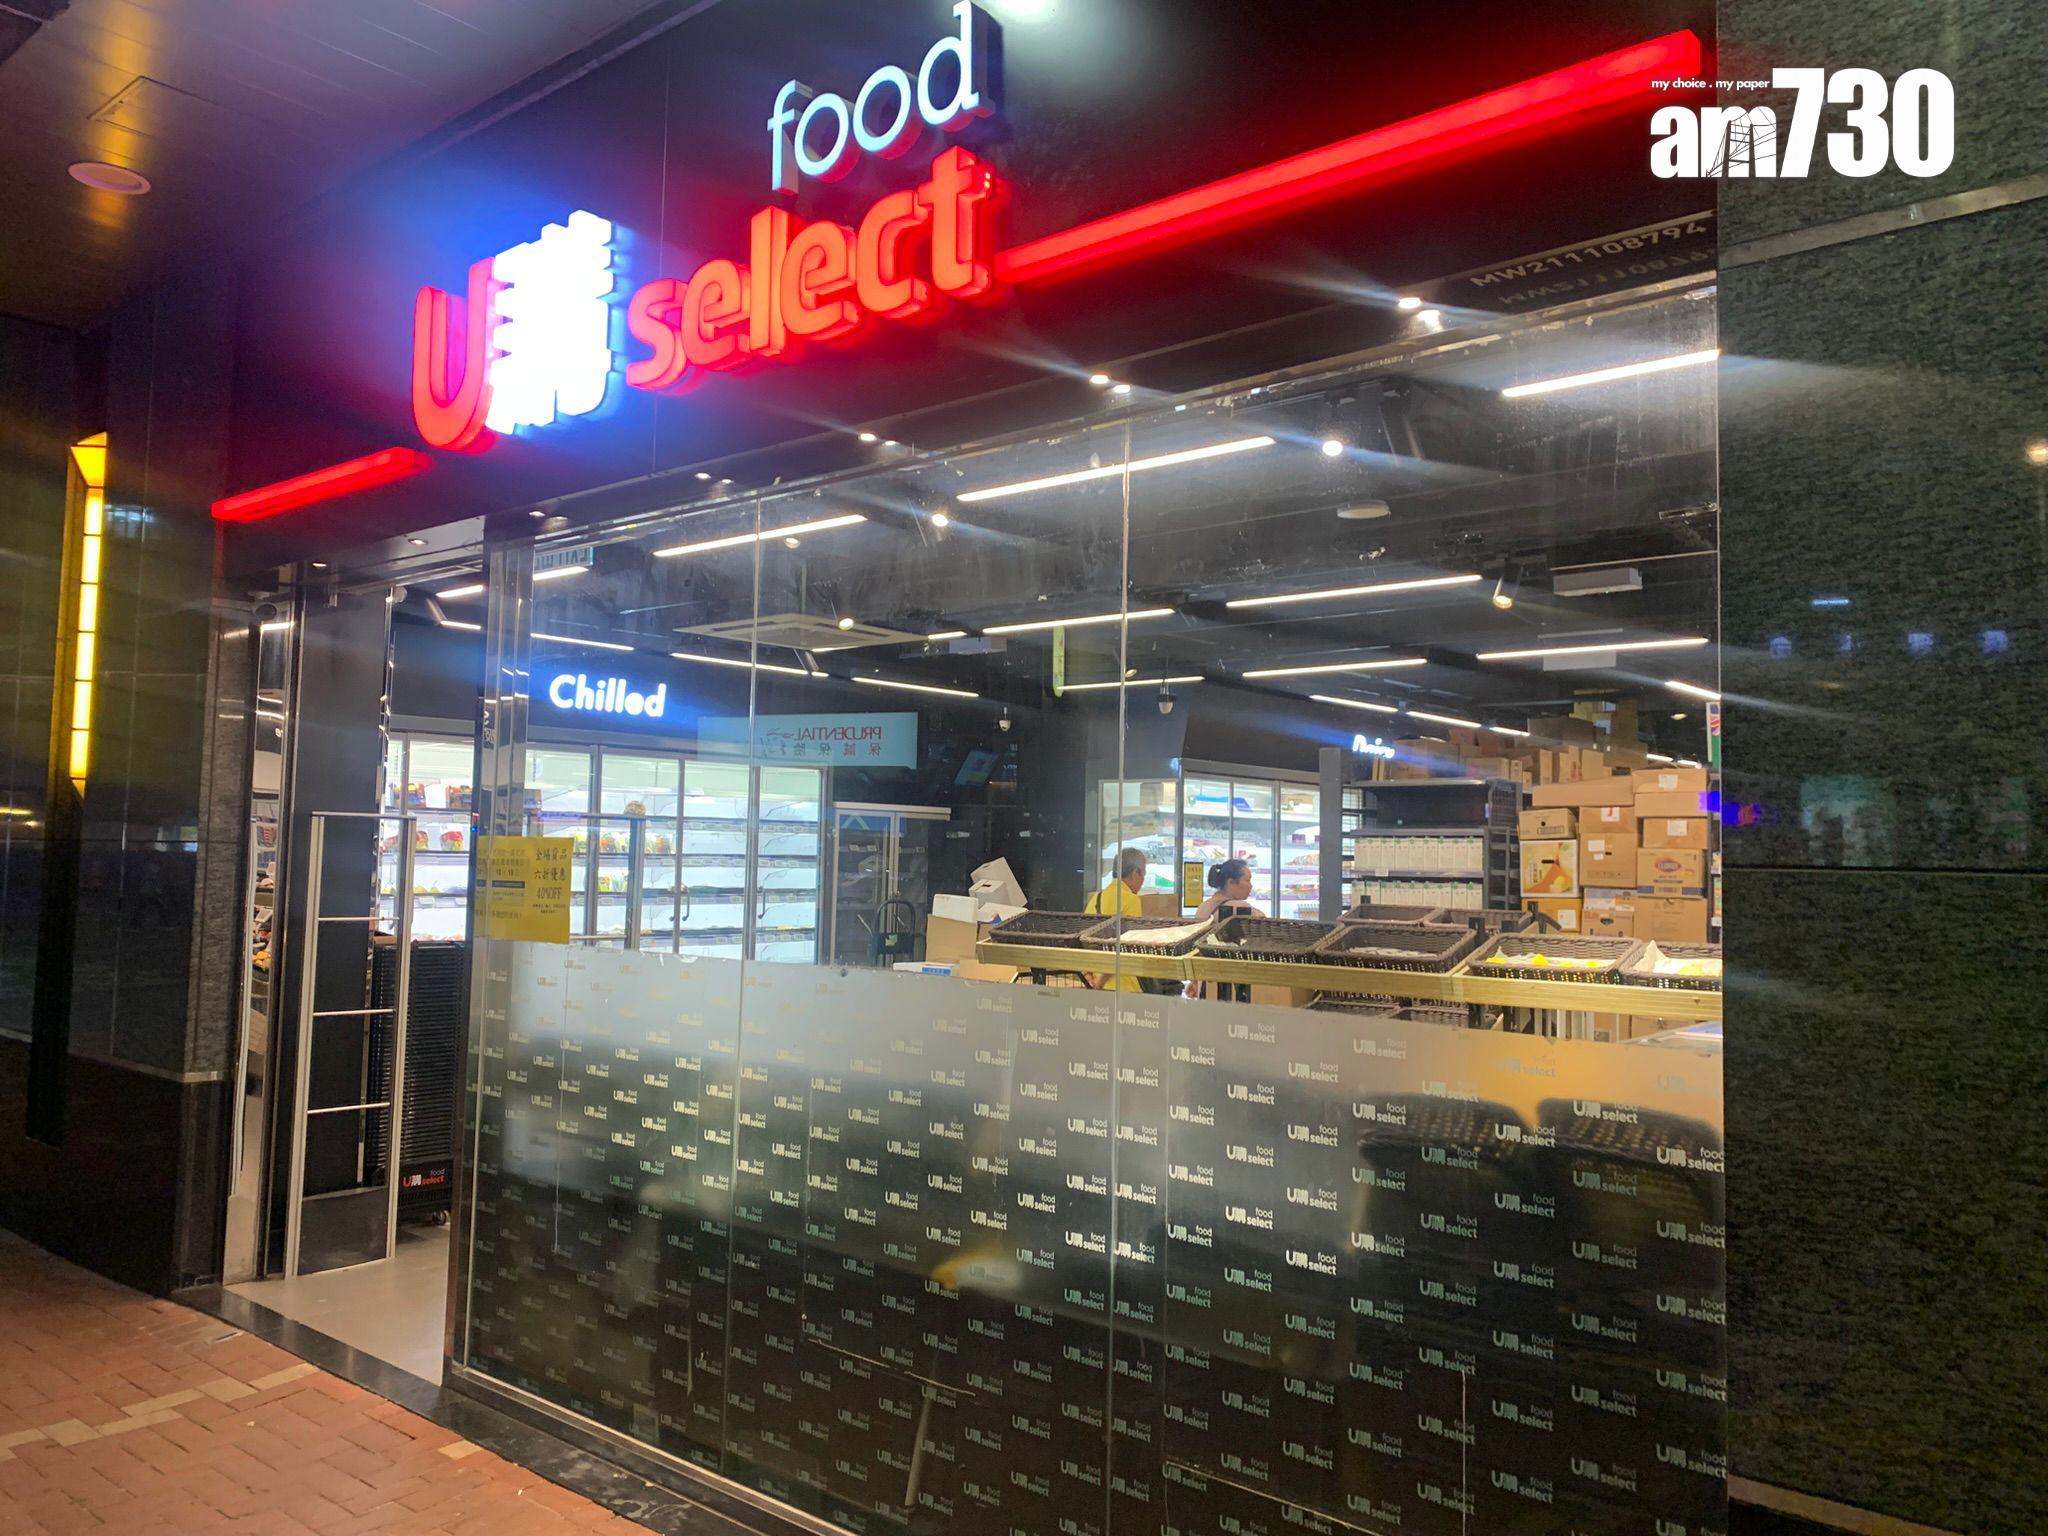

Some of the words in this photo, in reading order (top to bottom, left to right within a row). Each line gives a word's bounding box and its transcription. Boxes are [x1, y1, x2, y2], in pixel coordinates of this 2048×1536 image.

[767, 0, 981, 190] food
[1469, 222, 1707, 287] MW211108794
[626, 145, 992, 389] select
[1257, 1024, 1275, 1034] food
[1249, 1032, 1275, 1043] select
[1198, 1047, 1215, 1056] food
[1191, 1055, 1215, 1065] select
[1257, 1086, 1274, 1095] food
[1249, 1093, 1274, 1104] select
[1198, 1106, 1214, 1117] food
[1386, 1104, 1406, 1114] food
[1190, 1114, 1214, 1126] select
[1377, 1113, 1406, 1125] select
[1319, 1125, 1337, 1136] food
[1532, 1124, 1555, 1136] food
[1310, 1134, 1337, 1146] select
[1522, 1134, 1555, 1147] select
[1256, 1146, 1273, 1157] food
[1457, 1147, 1478, 1159] food
[1248, 1154, 1273, 1167] select
[1447, 1157, 1478, 1170] select
[1385, 1169, 1405, 1181] food
[1376, 1178, 1405, 1191] select
[1318, 1189, 1337, 1199] food
[1310, 1197, 1337, 1210] select
[1532, 1195, 1554, 1206] food
[1255, 1208, 1273, 1218] food
[1522, 1203, 1554, 1217] select
[1247, 1216, 1273, 1229] select
[1456, 1215, 1477, 1227] food
[1195, 1226, 1212, 1237] food
[1446, 1224, 1477, 1238] select
[1187, 1234, 1212, 1247] select
[1384, 1235, 1404, 1245] food
[1376, 1242, 1404, 1257] select
[1613, 1245, 1637, 1257] food
[1317, 1253, 1336, 1264] food
[1602, 1254, 1637, 1269] select
[1309, 1261, 1336, 1275] select
[1531, 1264, 1553, 1276] food
[1254, 1270, 1271, 1281] food
[1521, 1273, 1553, 1288] select
[1246, 1278, 1271, 1292] select
[1455, 1283, 1476, 1294] food
[1194, 1287, 1211, 1296] food
[1187, 1294, 1211, 1307] select
[1445, 1292, 1476, 1306] select
[1612, 1317, 1636, 1329] food
[1601, 1326, 1636, 1342] select
[1530, 1335, 1553, 1347] food
[1520, 1343, 1553, 1359] select
